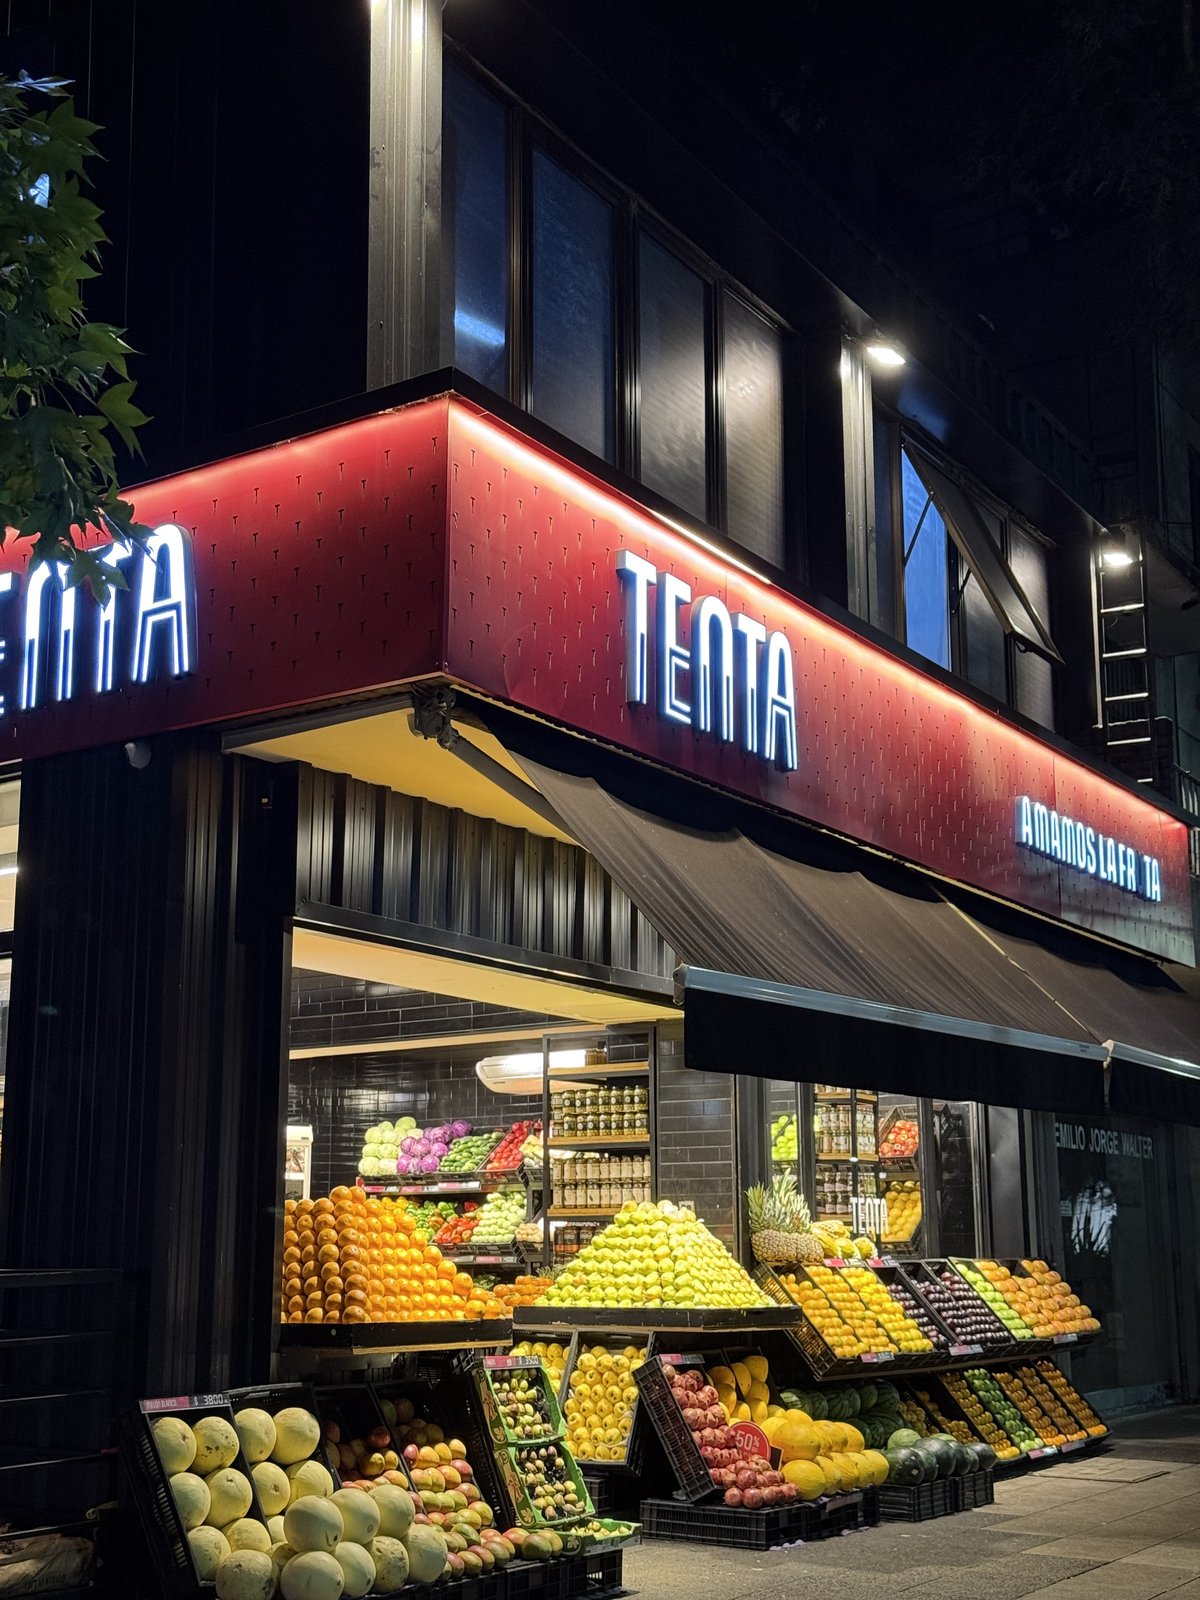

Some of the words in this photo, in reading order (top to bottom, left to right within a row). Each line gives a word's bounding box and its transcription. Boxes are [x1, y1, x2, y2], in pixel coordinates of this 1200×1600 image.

[0, 524, 193, 715] NTA
[616, 549, 798, 770] TENTA
[1016, 796, 1096, 874] AMAMOS
[1098, 834, 1118, 884] LA
[1054, 1122, 1086, 1151] EMILIO
[1089, 1127, 1120, 1155] JORGE
[1121, 1131, 1153, 1160] WALTER
[849, 1196, 890, 1235] TENTA
[193, 1396, 199, 1406] $
[203, 1393, 224, 1406] 3800
